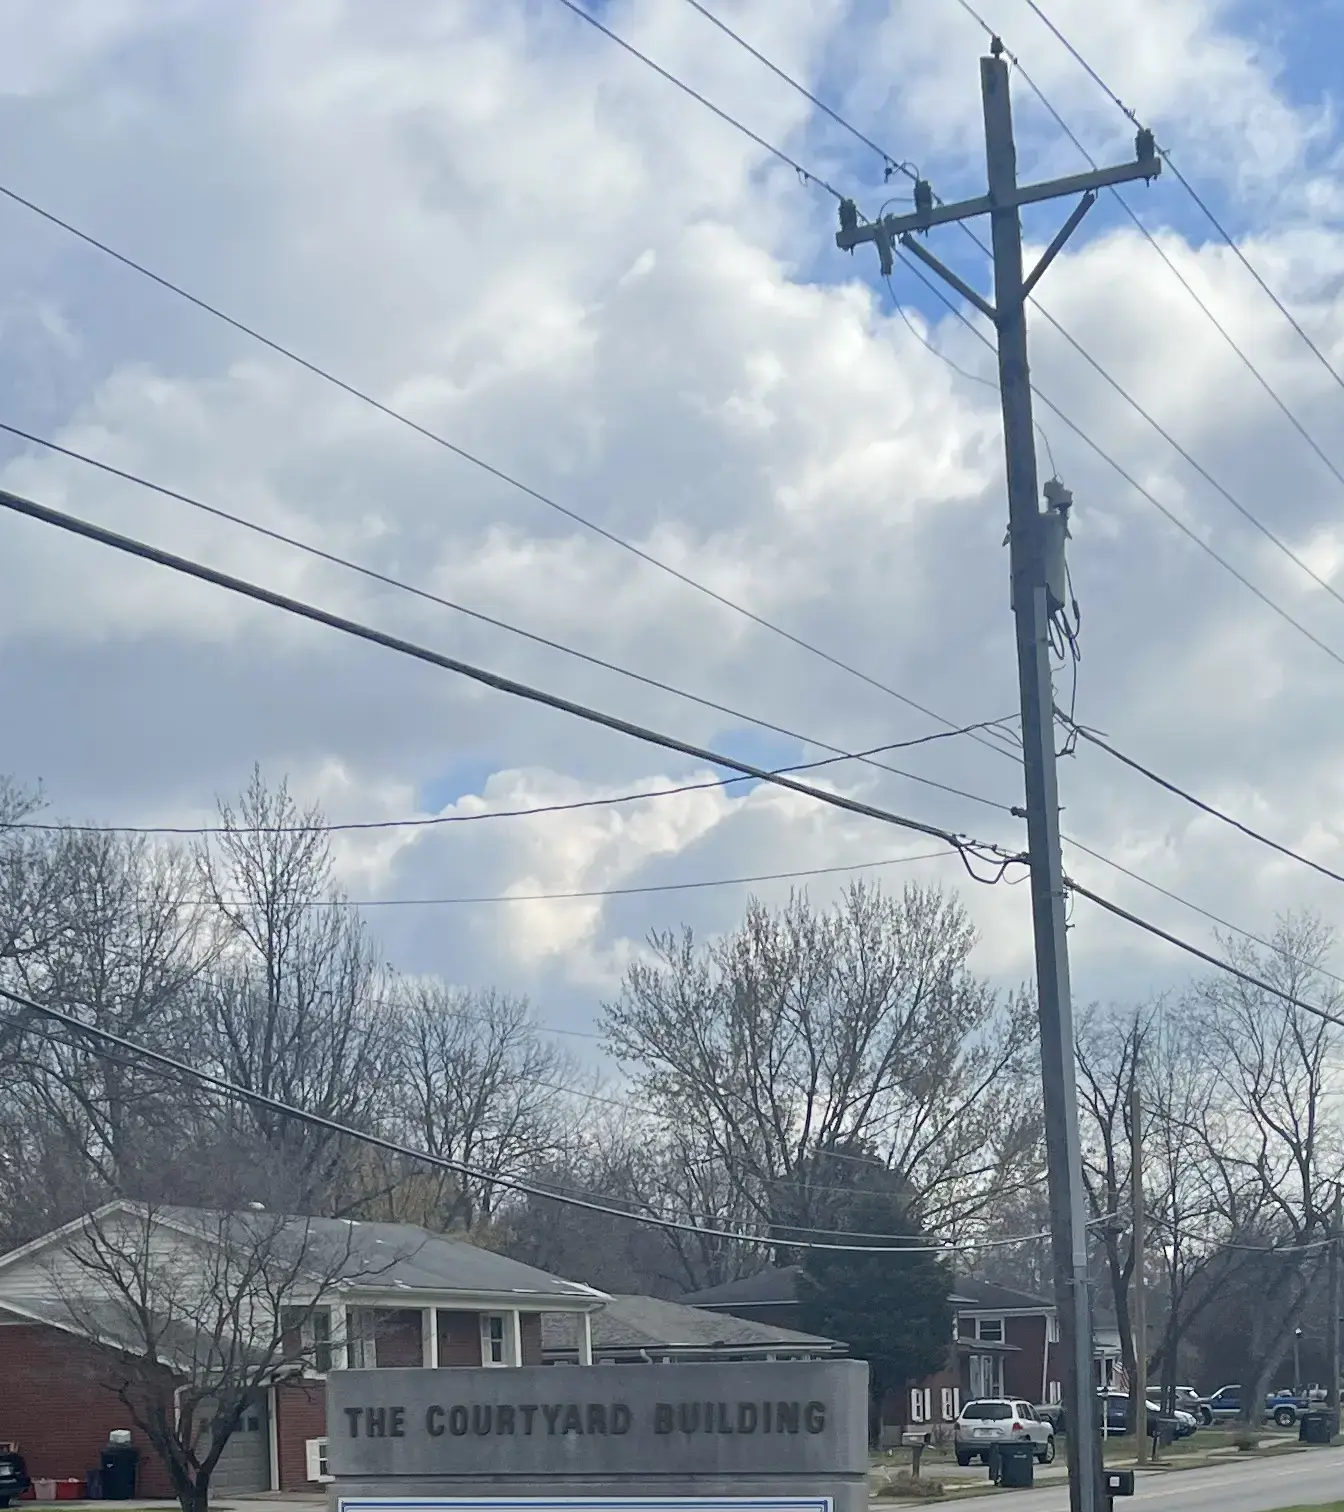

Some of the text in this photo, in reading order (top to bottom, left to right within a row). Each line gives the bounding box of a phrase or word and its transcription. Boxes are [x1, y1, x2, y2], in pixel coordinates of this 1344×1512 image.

[343, 1400, 826, 1437] THE COURTYARD BUILDING
